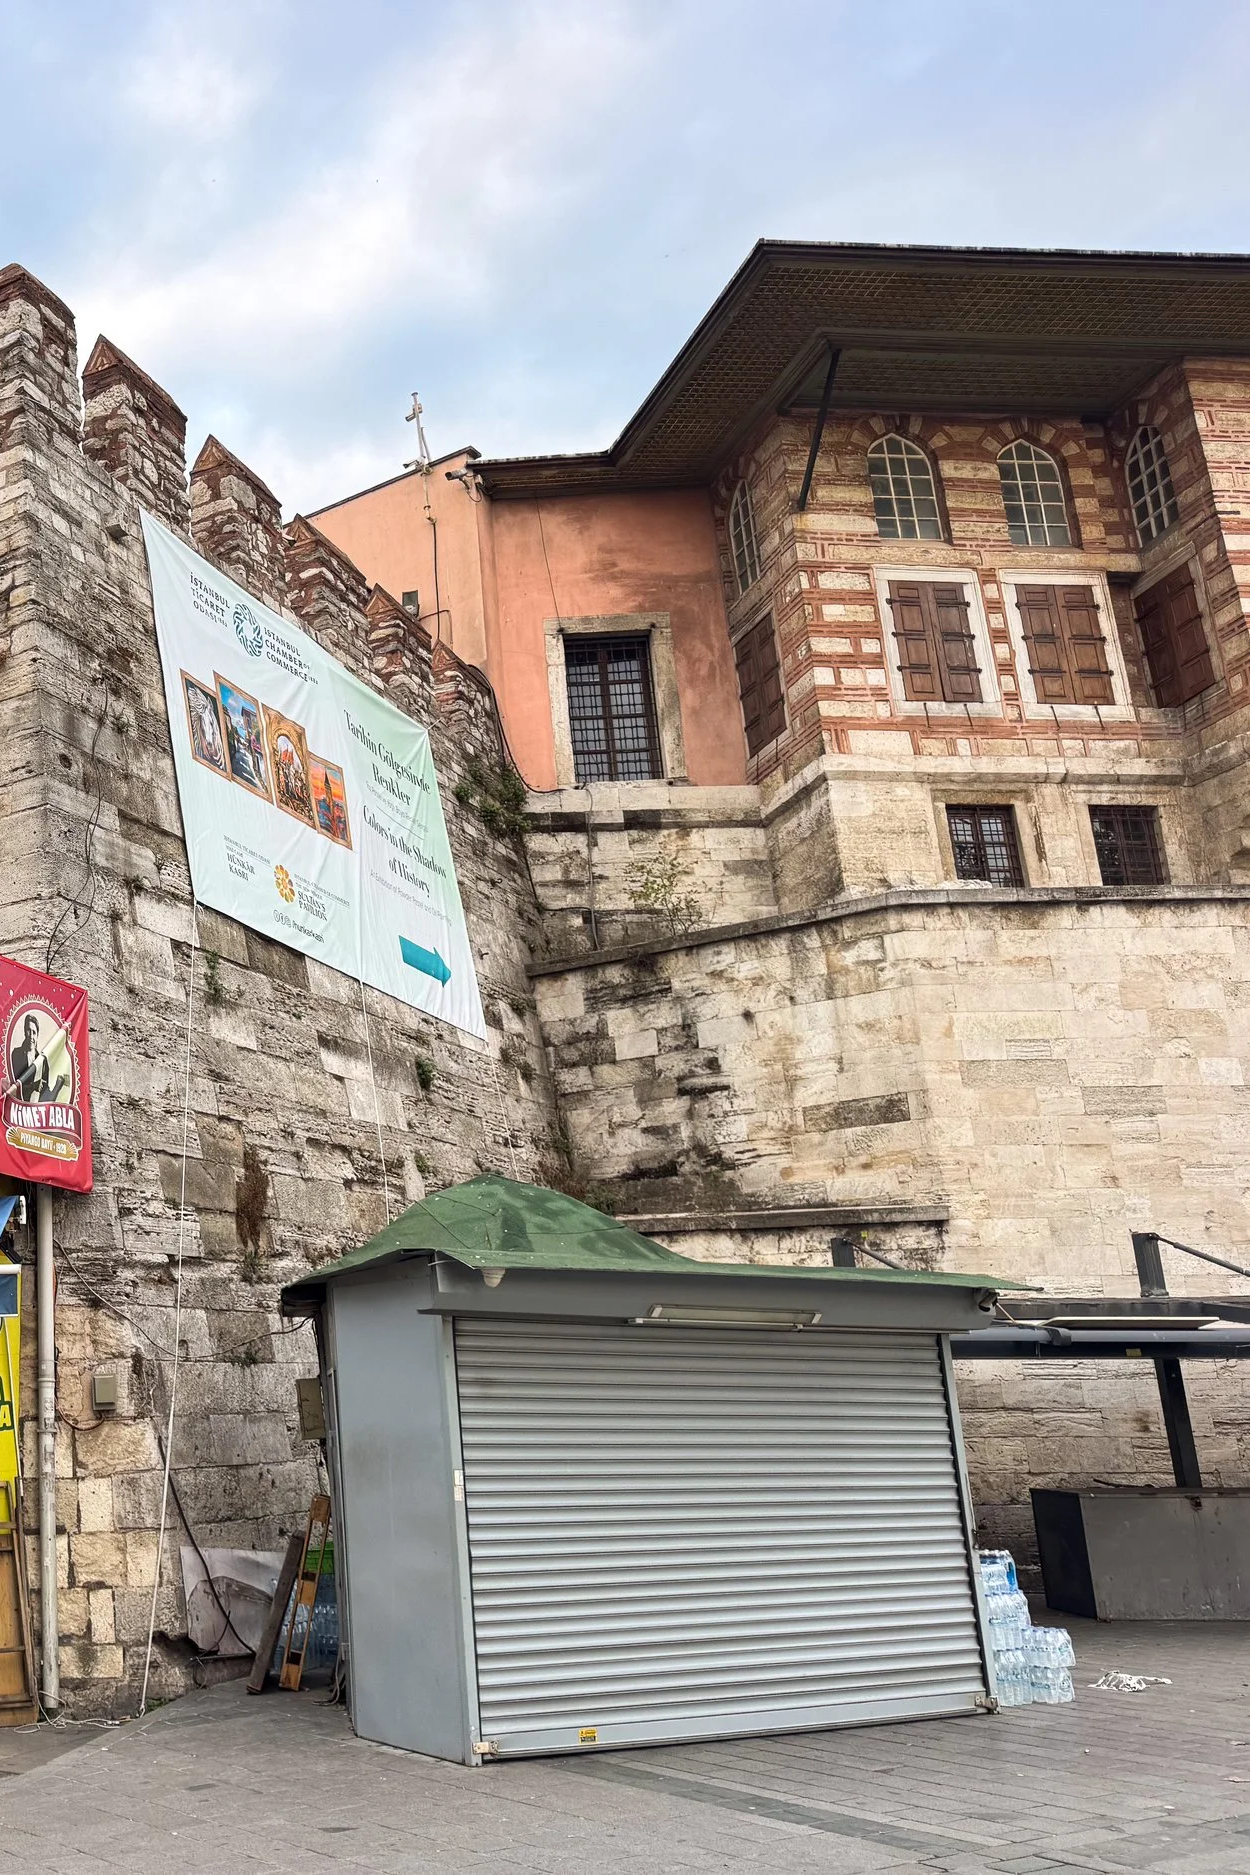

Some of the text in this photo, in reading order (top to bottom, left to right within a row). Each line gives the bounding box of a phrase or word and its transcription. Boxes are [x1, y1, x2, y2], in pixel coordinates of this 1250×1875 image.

[190, 571, 230, 609] İSTANBUL
[191, 587, 225, 617] TİCARET
[193, 600, 218, 623] ODASI
[265, 640, 303, 669] CHAMBER
[266, 651, 308, 682] COMMERCE
[344, 709, 431, 795] Tarihin Gölgesinde
[372, 762, 411, 806] Renkler
[363, 805, 389, 841] Colors
[388, 828, 398, 848] in
[399, 836, 413, 858] the
[412, 845, 447, 878] Shadow
[389, 857, 430, 898] of History
[49, 1105, 75, 1130] ABLA
